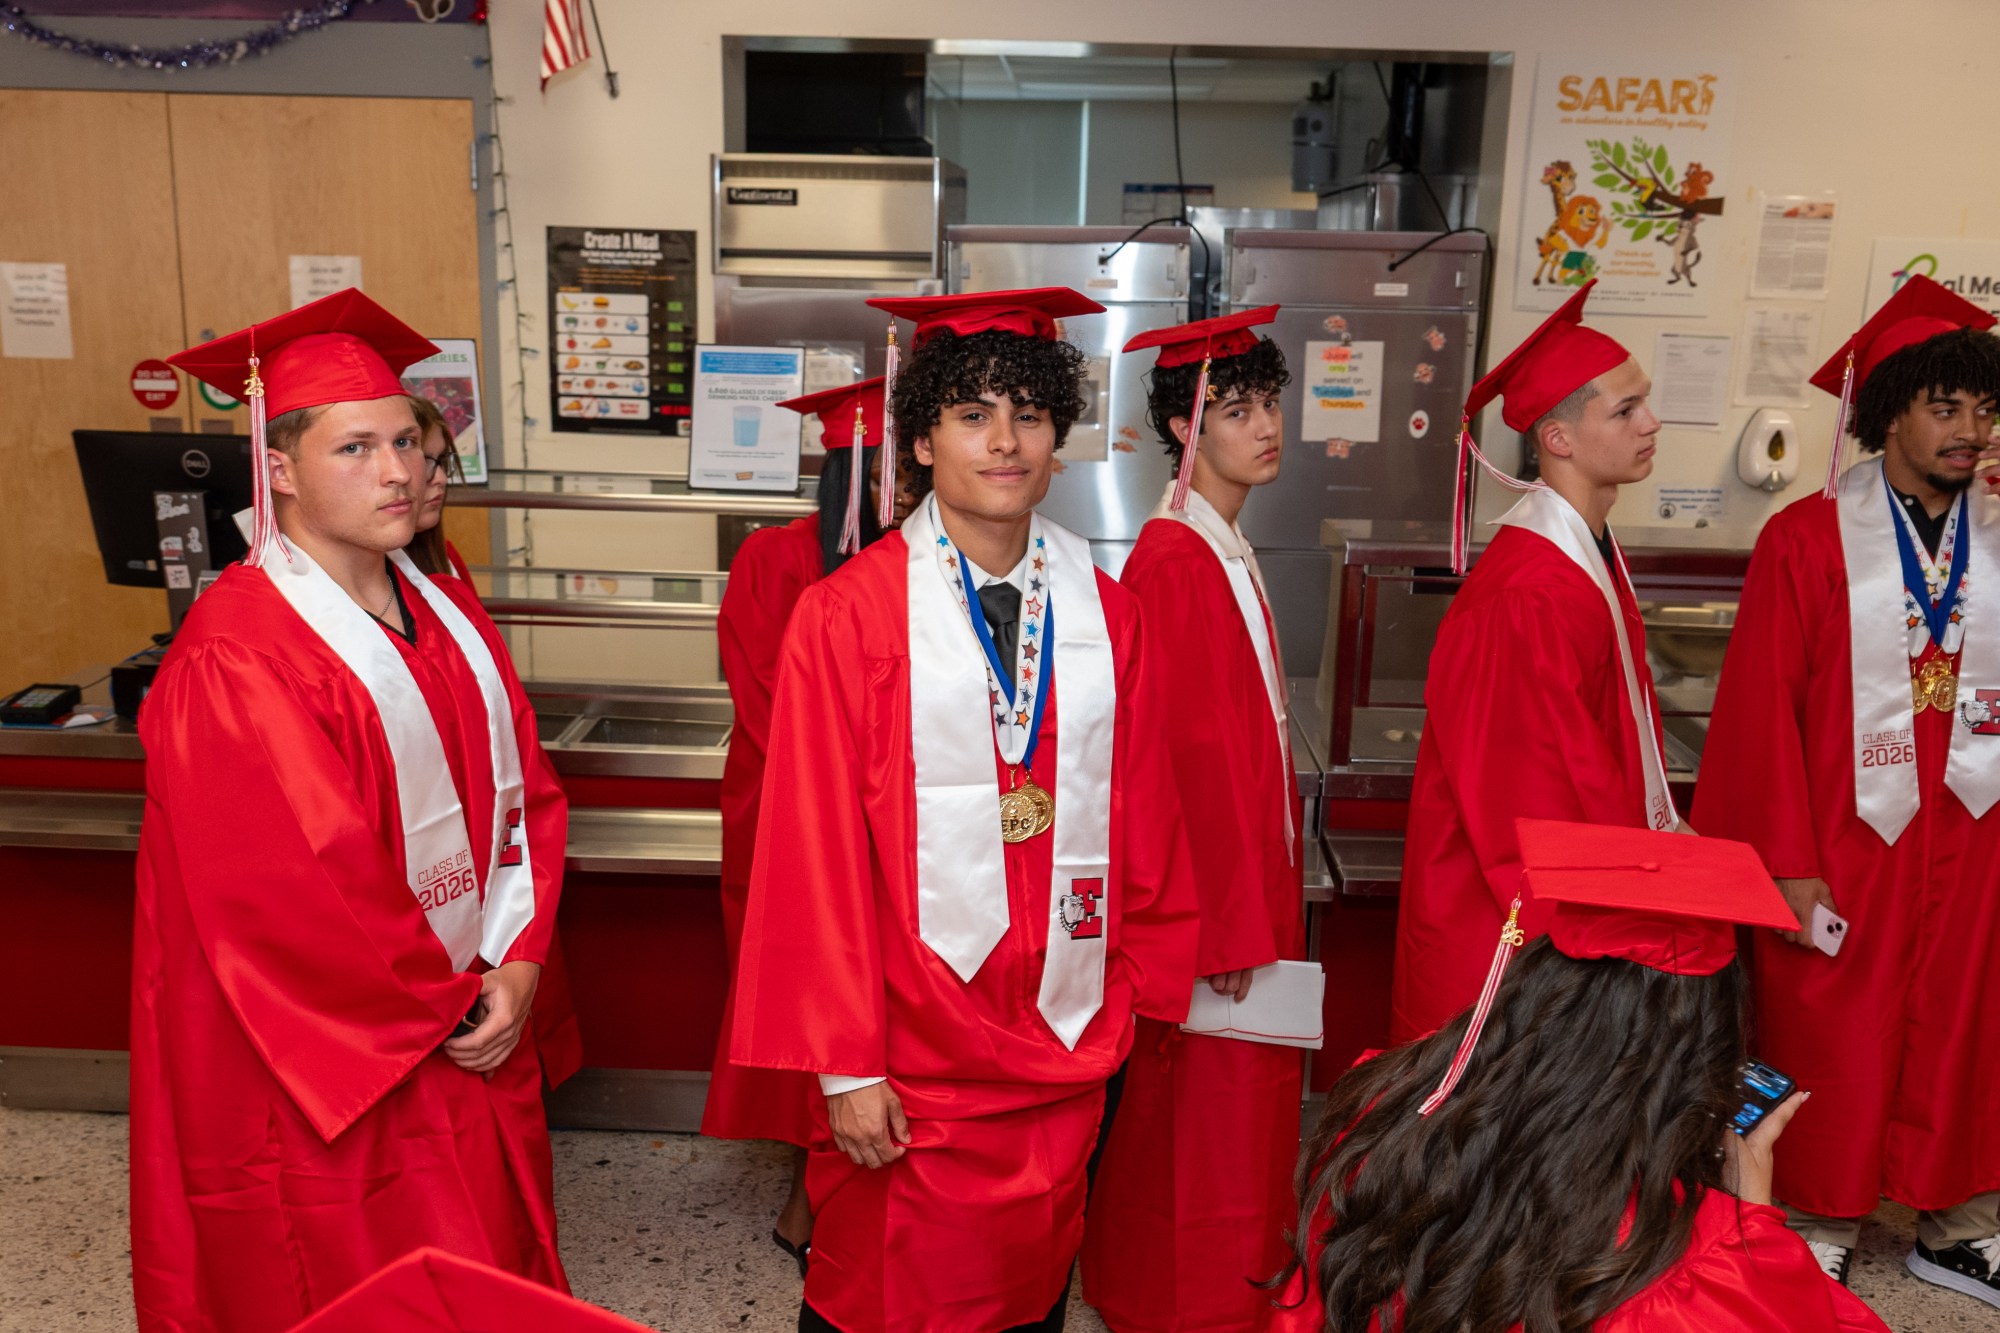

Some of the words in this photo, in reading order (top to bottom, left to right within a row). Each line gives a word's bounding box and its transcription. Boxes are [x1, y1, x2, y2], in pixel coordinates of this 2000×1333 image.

[584, 231, 621, 249] Create
[623, 231, 631, 250] A
[632, 232, 659, 251] Meal
[1323, 376, 1351, 384] served
[1321, 399, 1364, 409] Thursdays
[187, 460, 208, 469] DELL
[1862, 730, 1896, 744] CLASS
[1899, 729, 1912, 741] OF
[1862, 745, 1914, 767] 2026
[417, 857, 453, 885] CLASS
[455, 849, 468, 866] OF
[418, 868, 475, 912] 2026
[1501, 925, 1524, 946] 26
